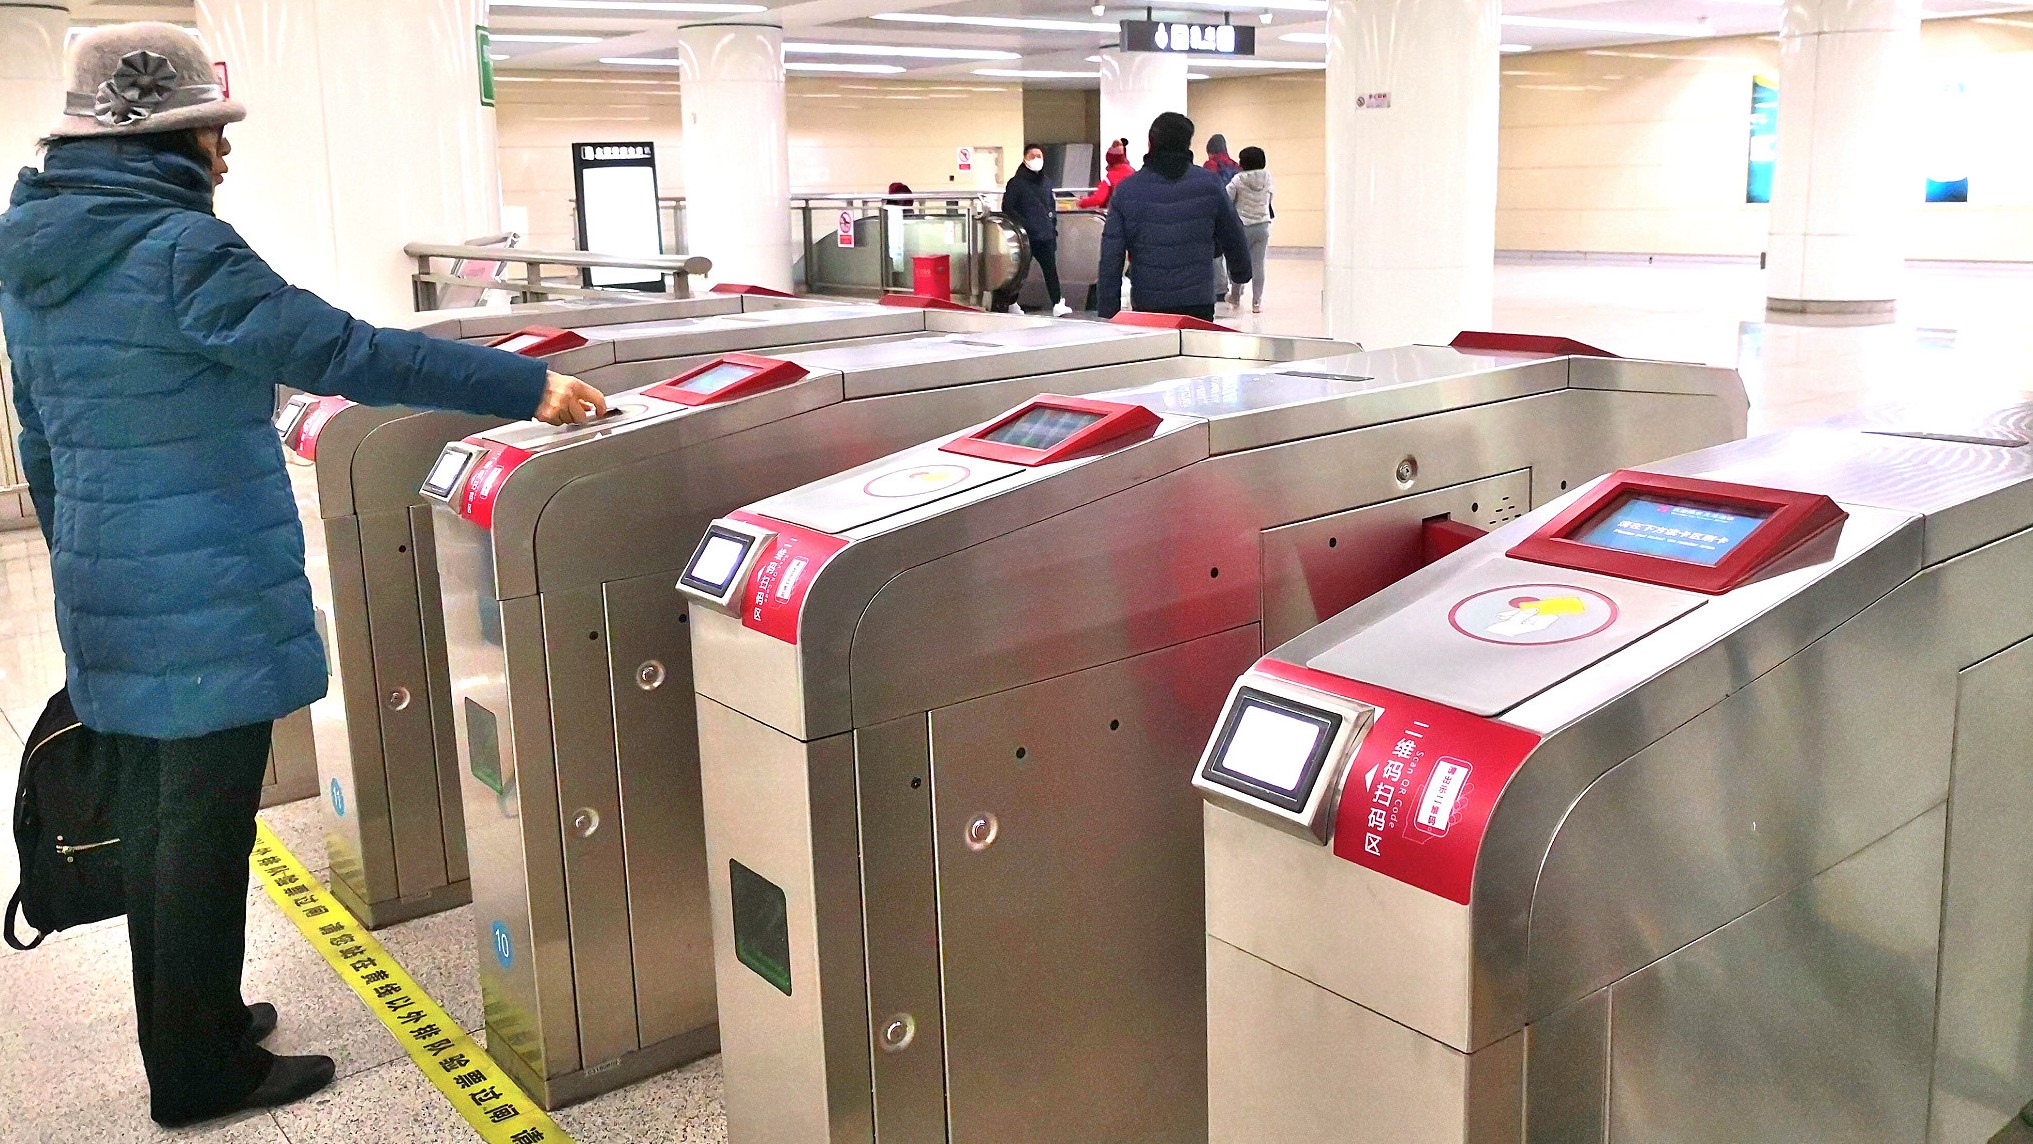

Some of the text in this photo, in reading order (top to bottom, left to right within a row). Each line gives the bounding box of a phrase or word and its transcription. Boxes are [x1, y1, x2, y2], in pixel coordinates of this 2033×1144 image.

[1364, 720, 1430, 856] 二维码扫码区
[1388, 750, 1424, 828] Scan QR Code
[495, 928, 509, 958] 10
[319, 921, 521, 1123] 请您站在黄线以外排队验票过闸
